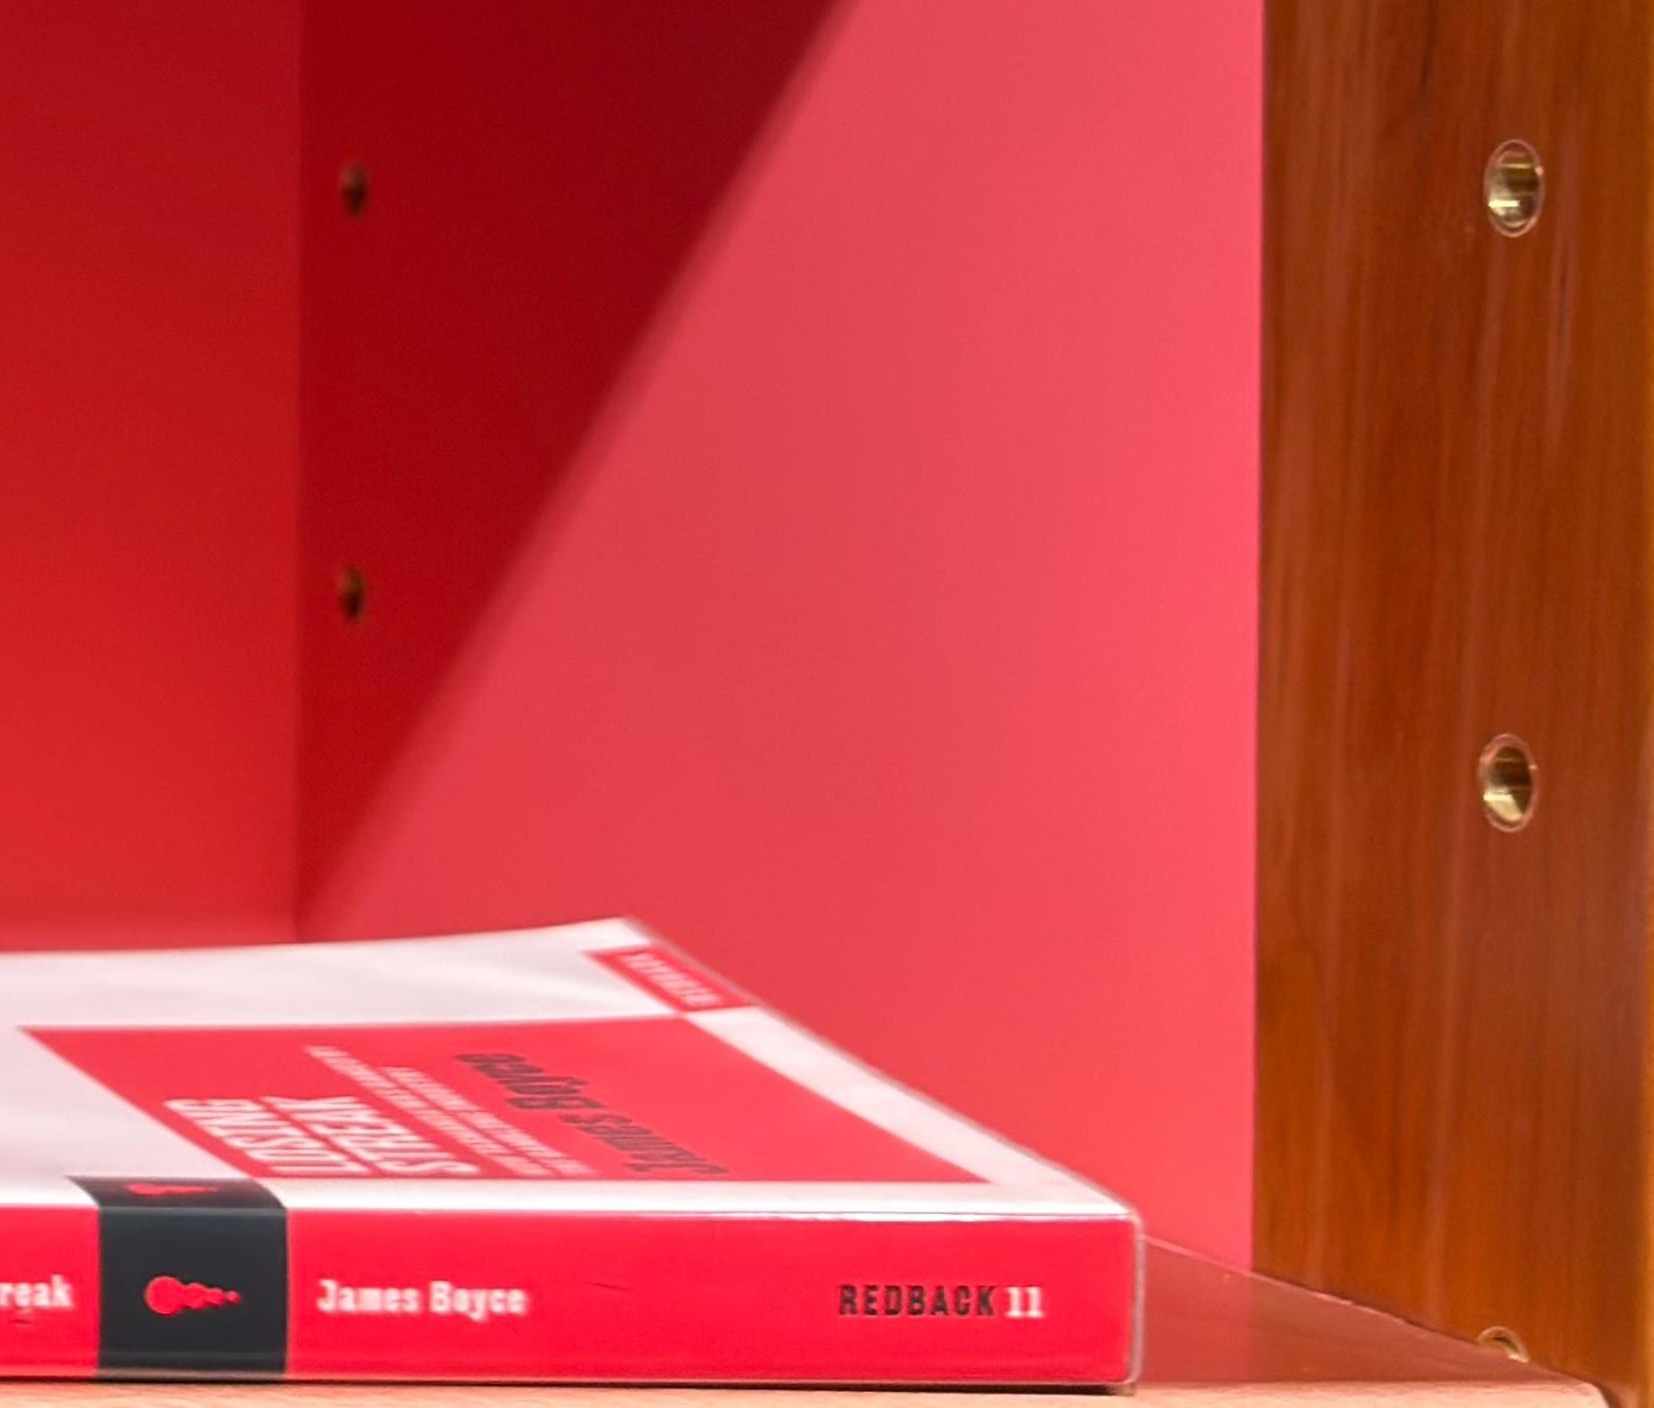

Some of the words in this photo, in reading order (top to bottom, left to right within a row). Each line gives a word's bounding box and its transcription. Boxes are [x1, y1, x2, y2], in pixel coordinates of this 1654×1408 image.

[316, 1278, 420, 1314] James
[429, 1281, 529, 1323] Boyce
[838, 1283, 998, 1318] REDBACK
[1003, 1284, 1046, 1320] 11
